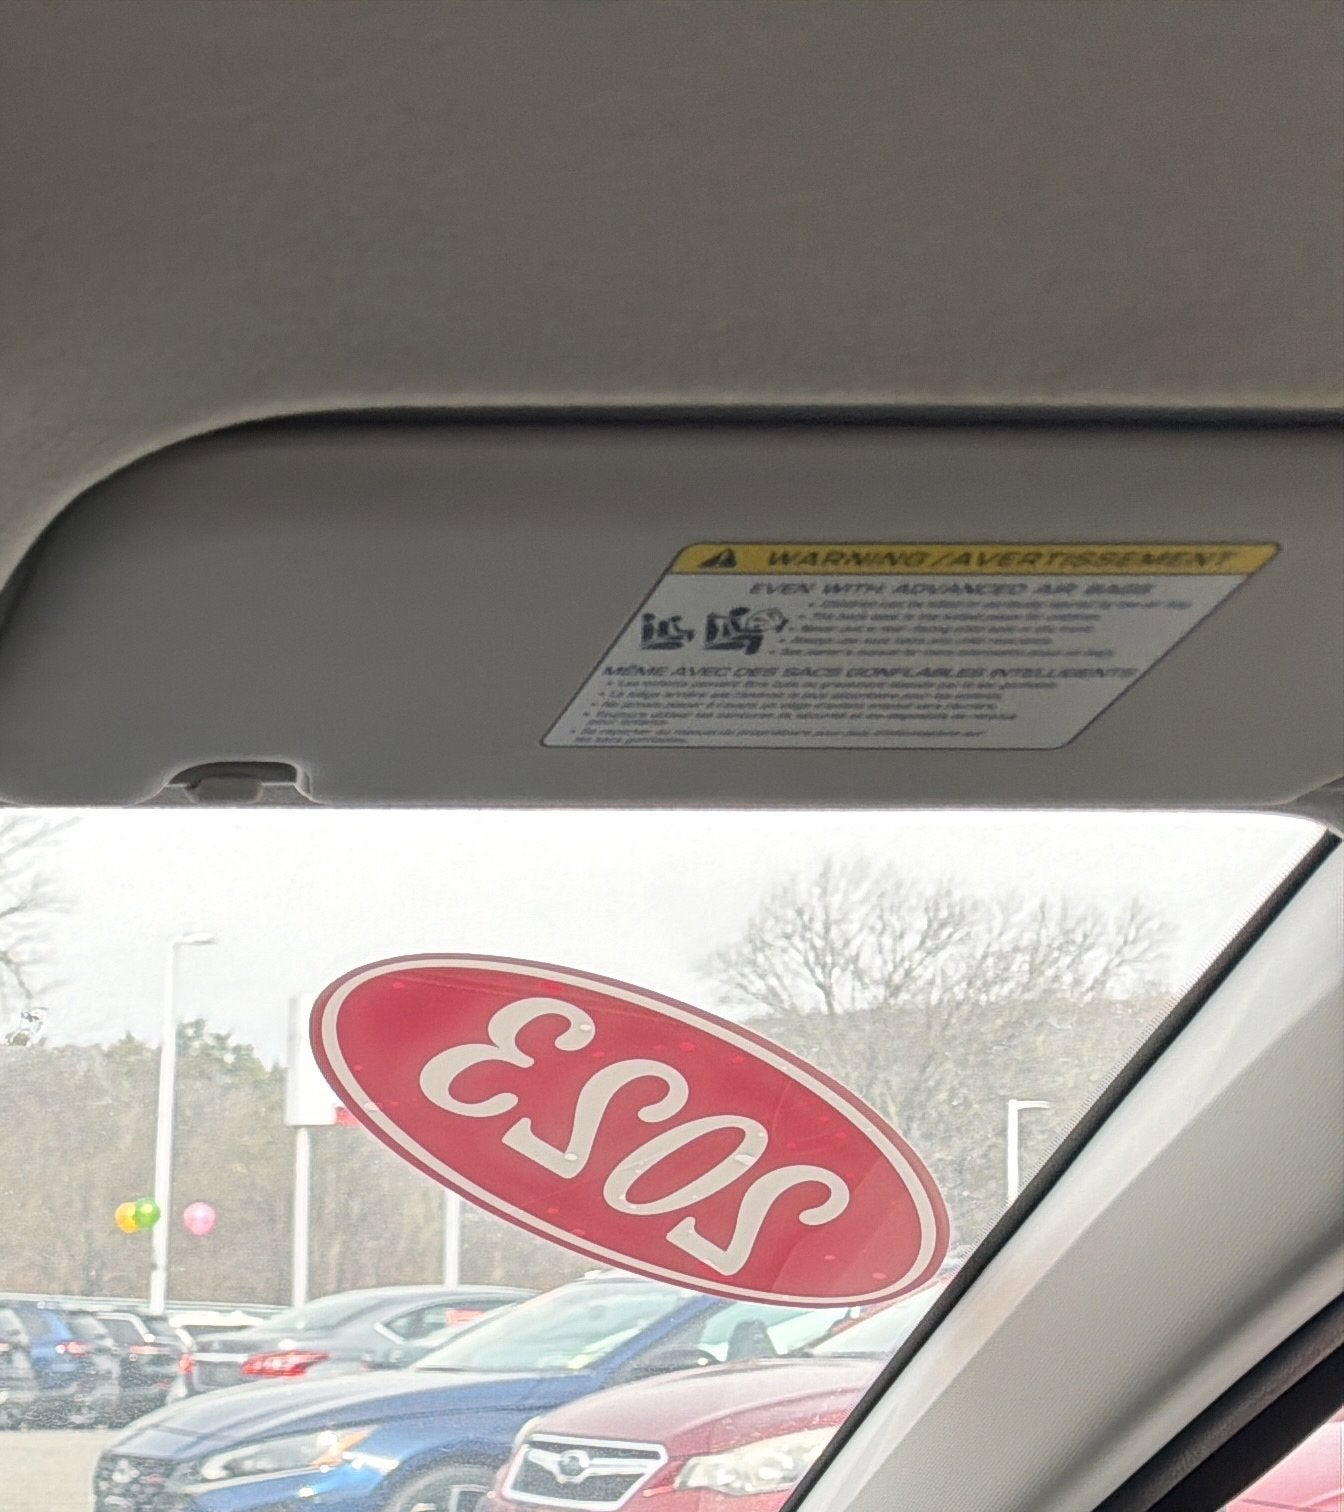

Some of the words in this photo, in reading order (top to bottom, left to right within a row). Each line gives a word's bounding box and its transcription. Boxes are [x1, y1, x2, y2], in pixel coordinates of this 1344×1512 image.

[749, 582, 813, 595] EVEN
[823, 582, 885, 595] WITH
[891, 582, 1028, 595] ADVANCED
[1034, 582, 1078, 595] AIR
[1084, 582, 1155, 595] BAGS
[670, 667, 732, 677] AVEC
[733, 667, 780, 677] DES
